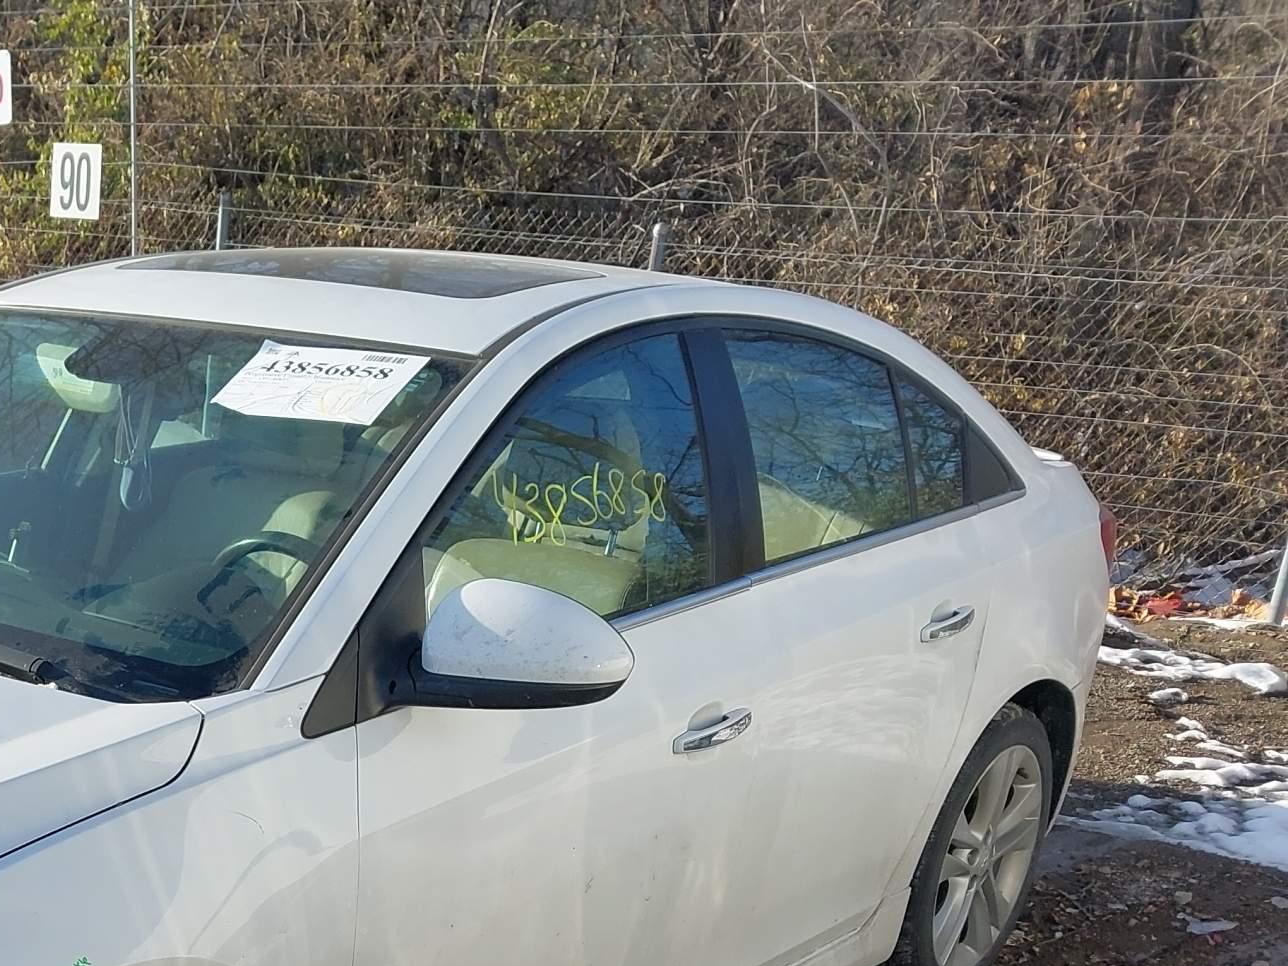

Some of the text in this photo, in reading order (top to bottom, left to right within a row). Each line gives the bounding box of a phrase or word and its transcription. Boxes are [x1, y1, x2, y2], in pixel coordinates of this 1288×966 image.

[59, 151, 92, 212] 90
[261, 358, 394, 380] 43856858
[491, 462, 667, 546] 43856858
